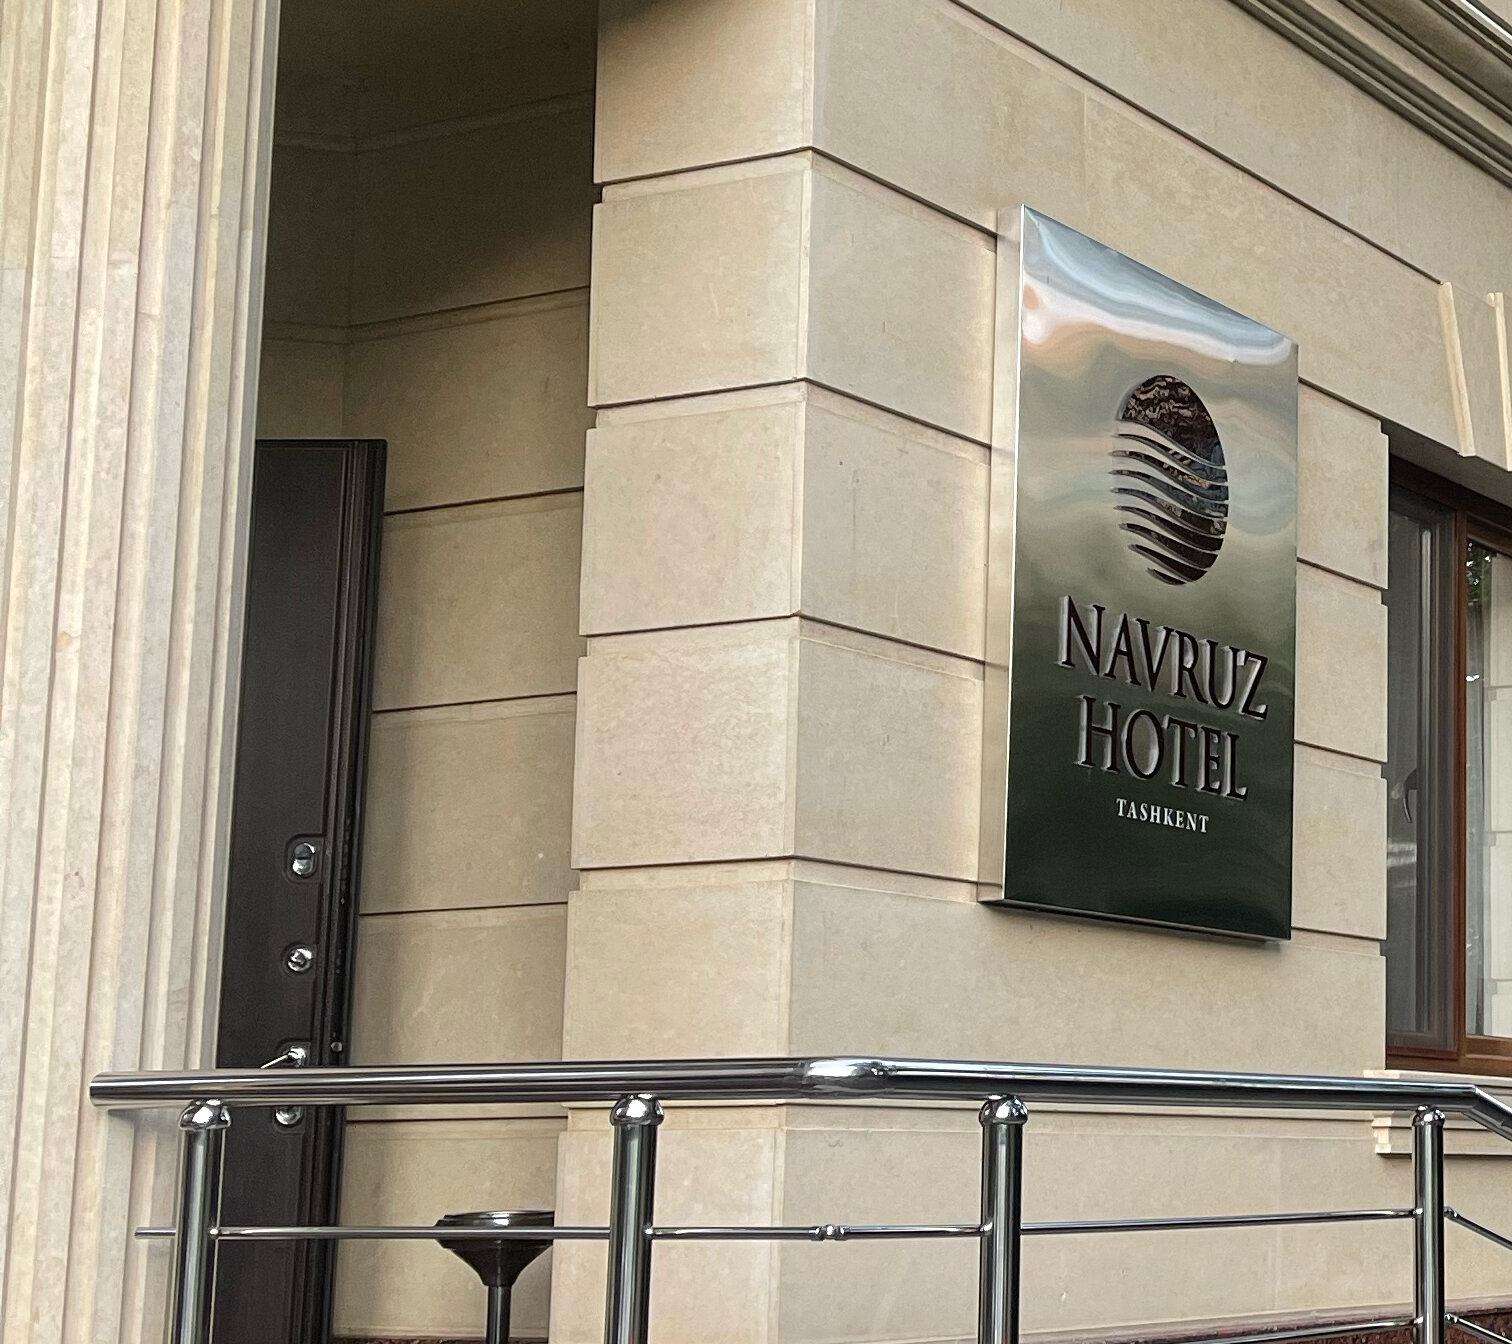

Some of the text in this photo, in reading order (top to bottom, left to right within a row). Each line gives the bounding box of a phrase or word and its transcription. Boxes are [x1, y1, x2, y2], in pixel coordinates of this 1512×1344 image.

[1056, 595, 1268, 720] NAVRUZ
[1075, 695, 1248, 801] HOTEL
[1116, 798, 1208, 833] TASHKENT
